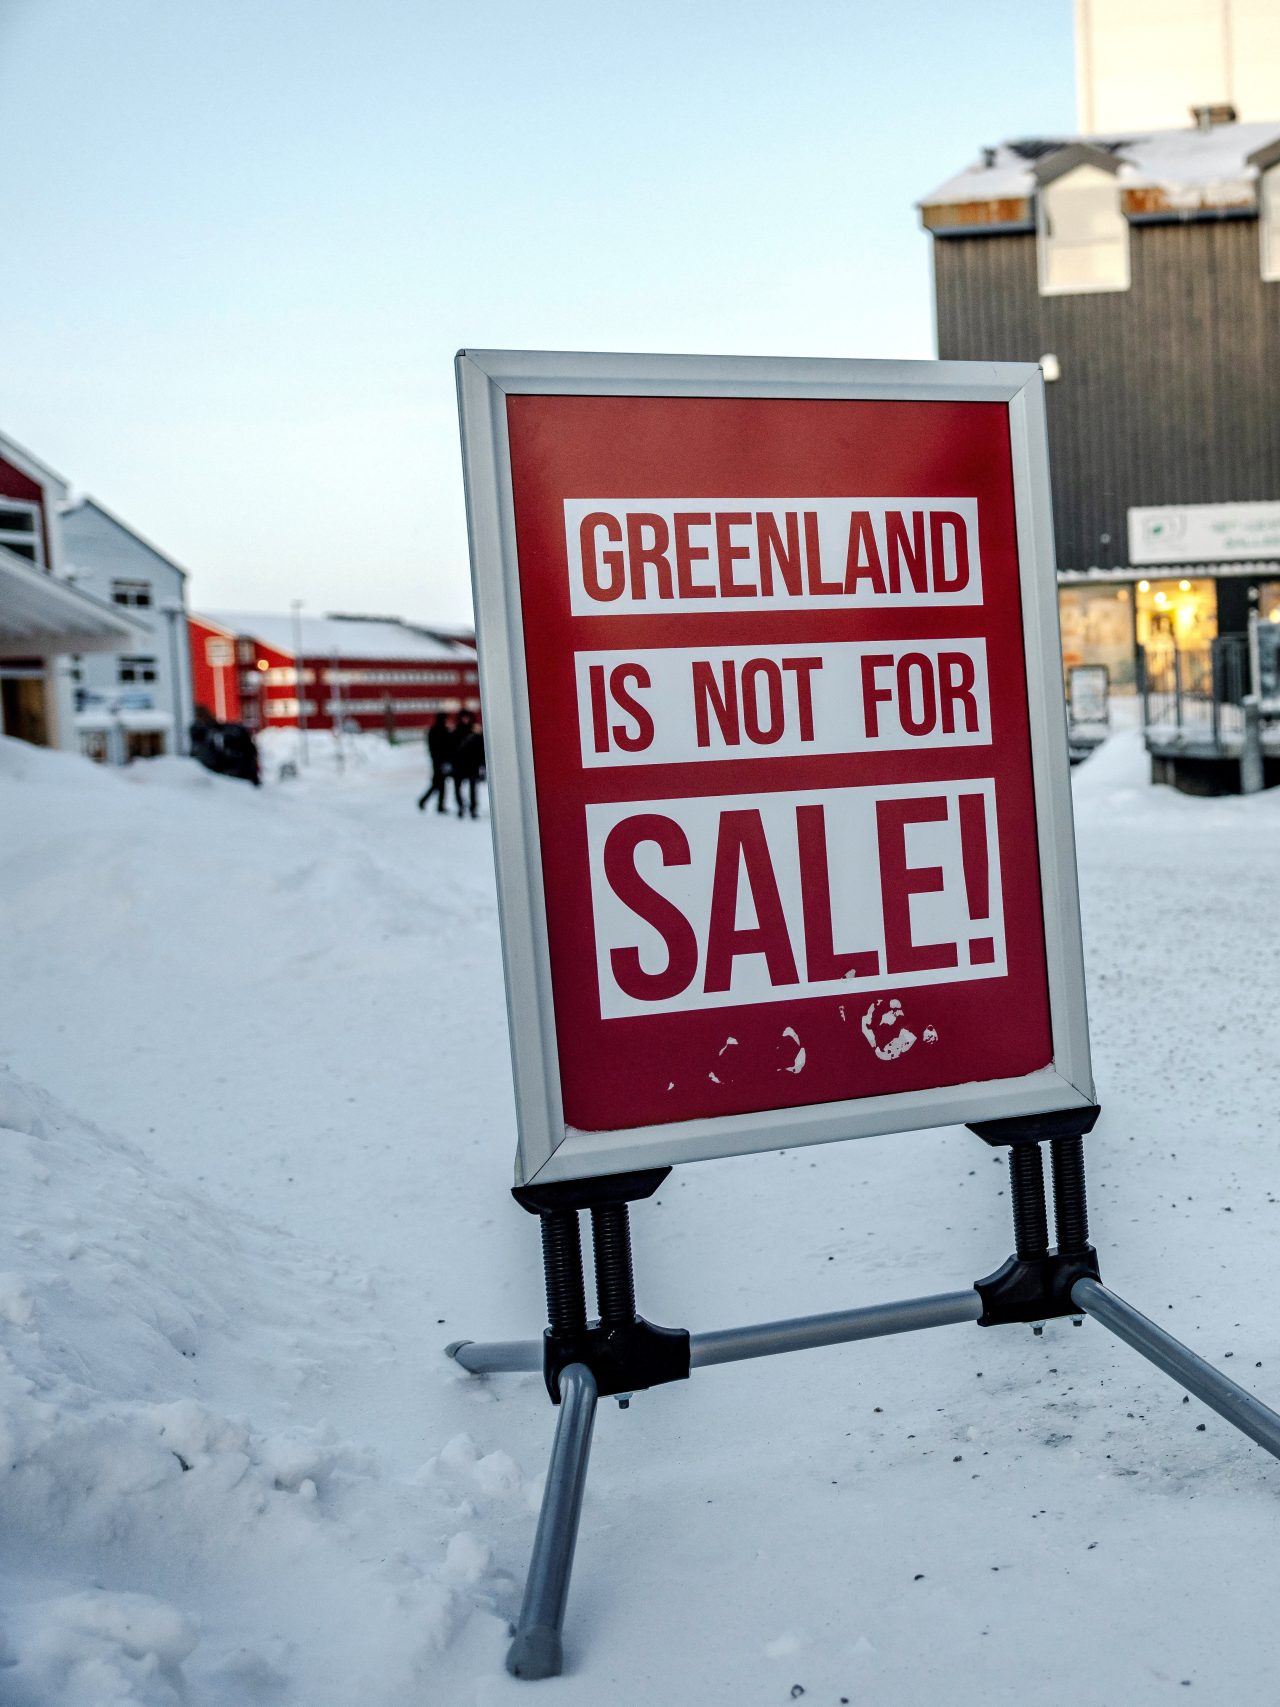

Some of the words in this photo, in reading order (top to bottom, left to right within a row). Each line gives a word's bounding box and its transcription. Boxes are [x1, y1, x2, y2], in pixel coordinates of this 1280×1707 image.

[580, 511, 971, 602] GREENLAND
[589, 662, 655, 753] IS
[692, 656, 823, 748] NOT
[860, 651, 979, 738] FOR
[604, 792, 996, 1002] SALE!
